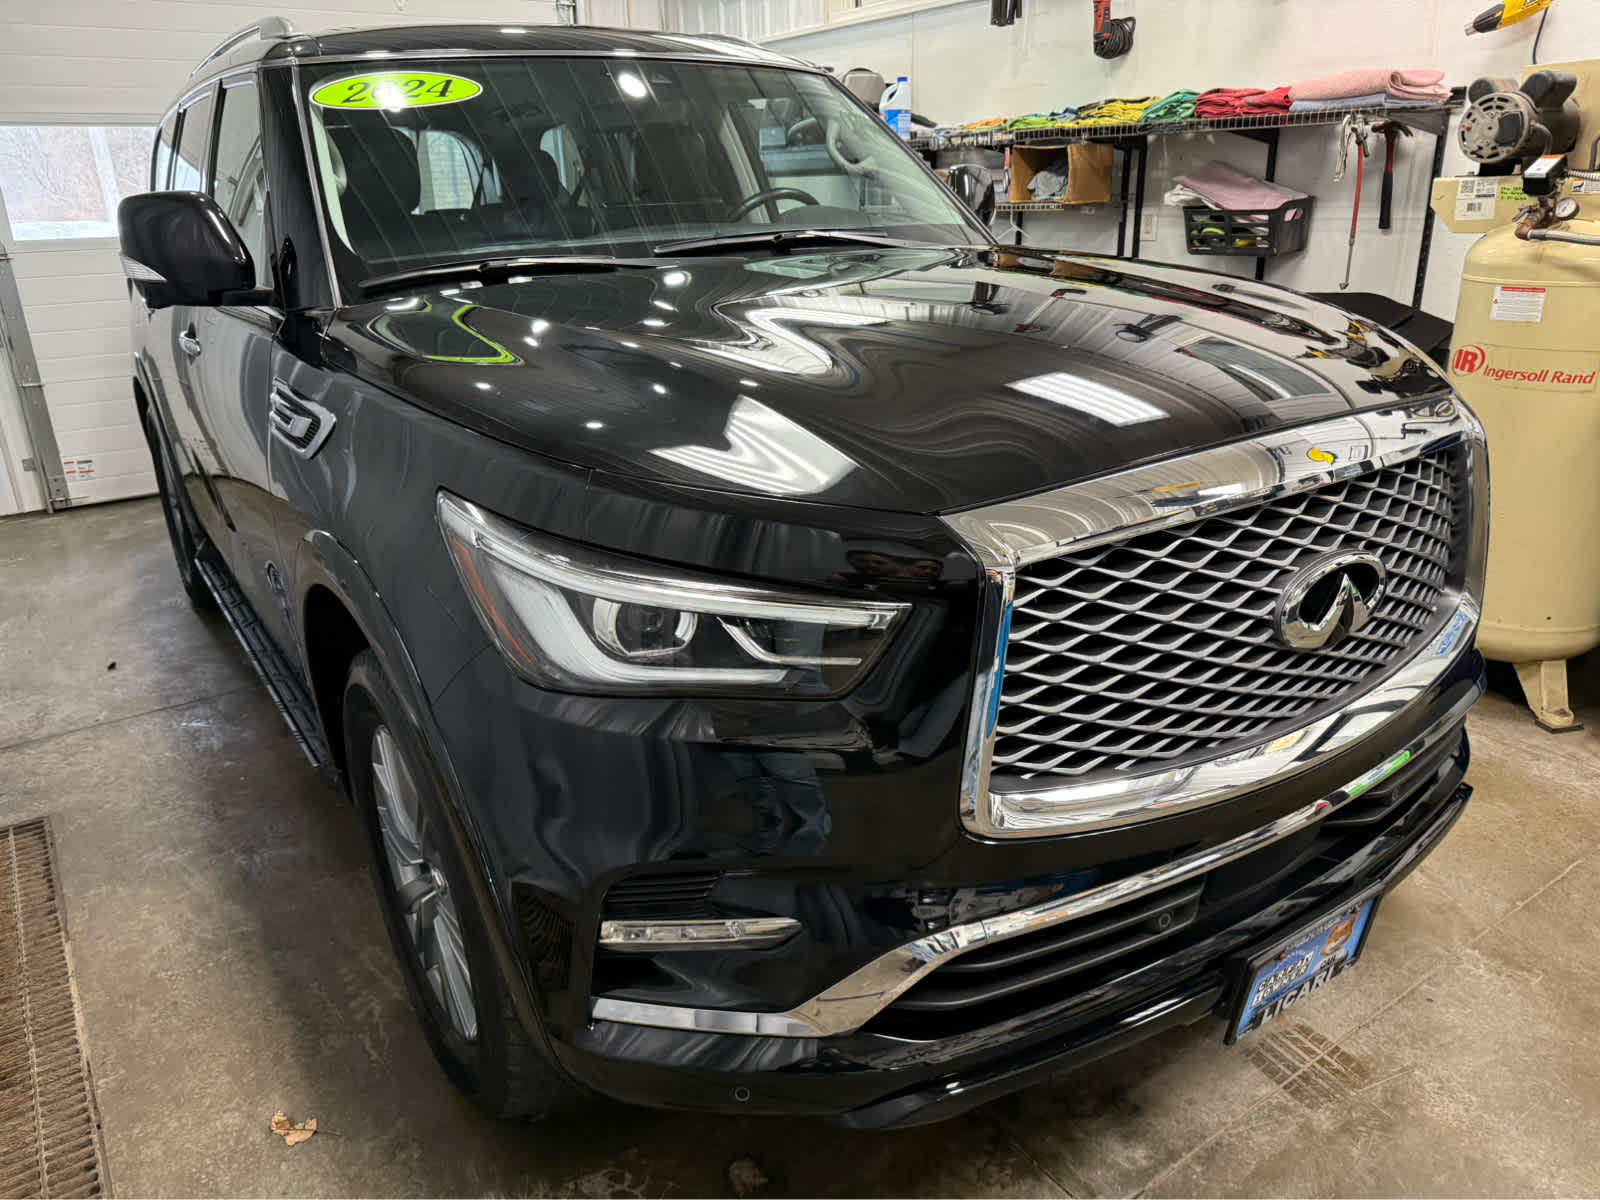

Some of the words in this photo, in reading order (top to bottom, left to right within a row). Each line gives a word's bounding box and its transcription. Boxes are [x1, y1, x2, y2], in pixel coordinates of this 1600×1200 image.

[1454, 348, 1479, 373] IR
[1483, 364, 1549, 382] Ingersoll
[1551, 371, 1596, 384] Rand
